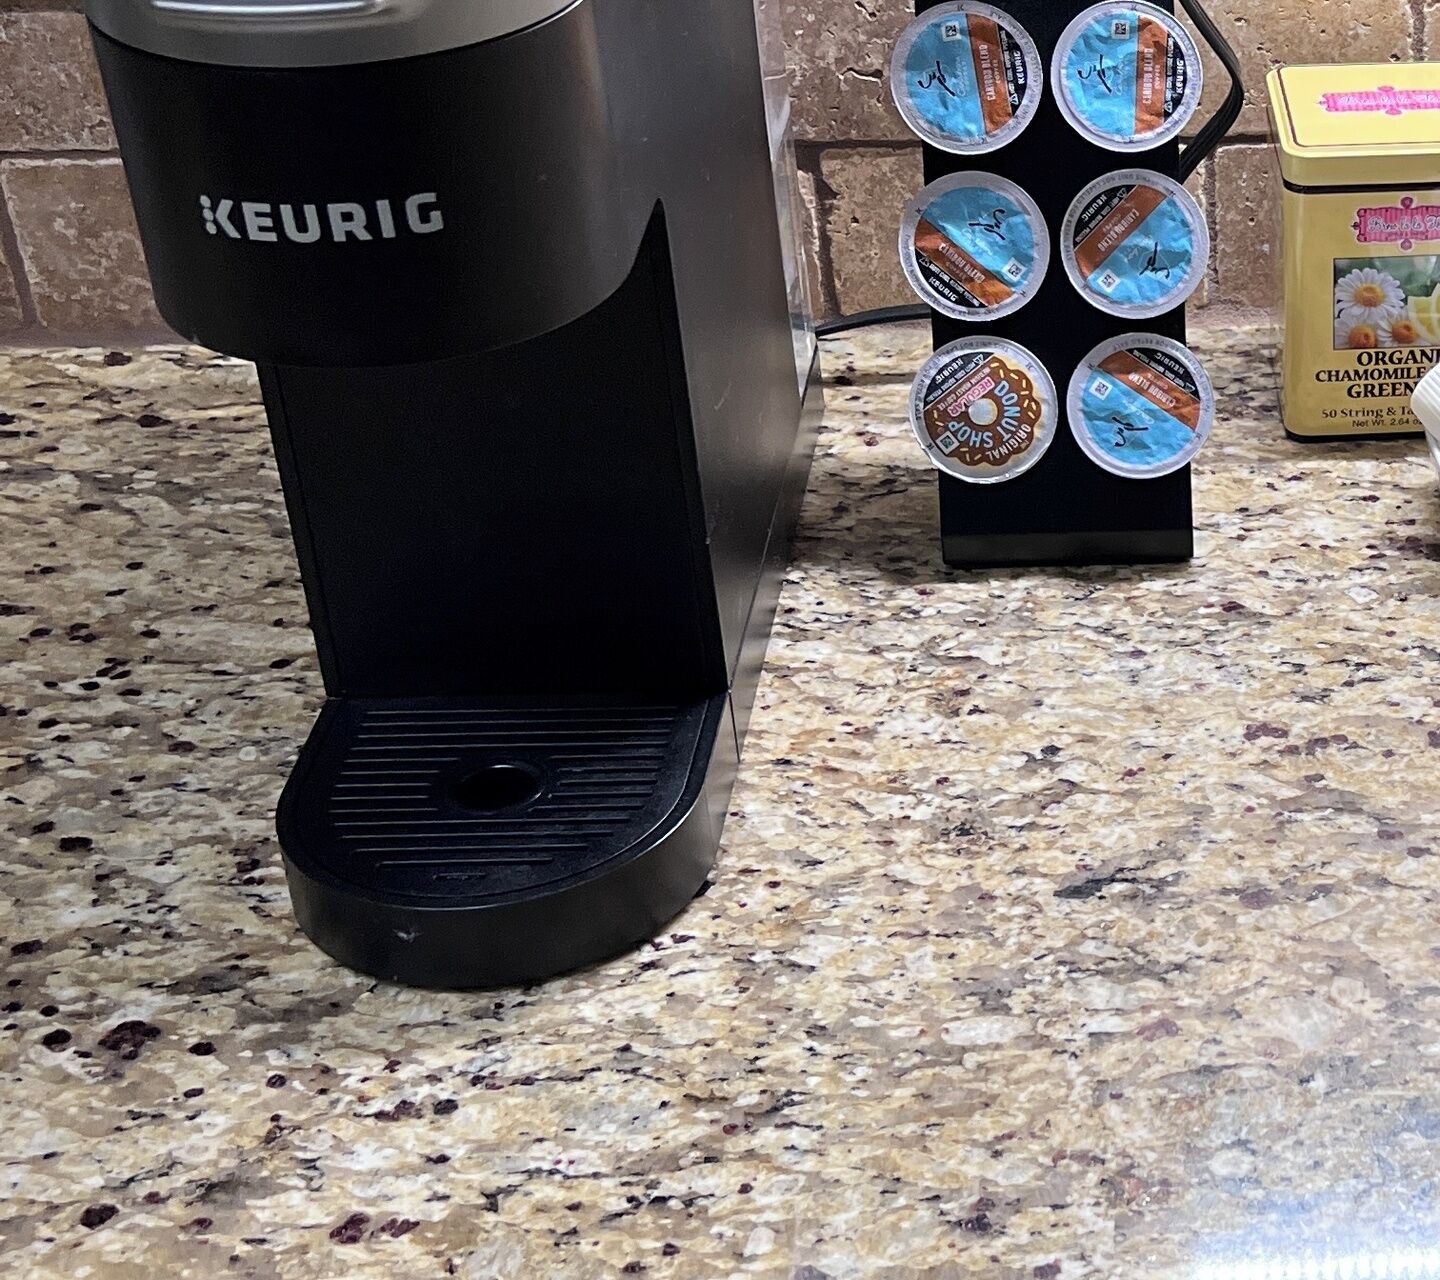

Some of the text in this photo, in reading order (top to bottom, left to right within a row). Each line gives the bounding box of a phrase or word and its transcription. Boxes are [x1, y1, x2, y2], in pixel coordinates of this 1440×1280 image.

[1014, 49, 1026, 85] KEURIG
[1175, 57, 1184, 94] KEURIG
[200, 192, 444, 243] KEURIG
[1079, 193, 1108, 223] KEURIG
[927, 275, 959, 303] KEURIG
[1315, 367, 1425, 382] CHAMOMILE
[1347, 381, 1417, 398] GREEN
[948, 378, 994, 416] REGULAR
[1322, 406, 1414, 419] 50 String & Ta
[947, 380, 1021, 448] DONUT SHOP
[1352, 418, 1369, 427] Net
[985, 423, 1032, 461] ORIGINAL
